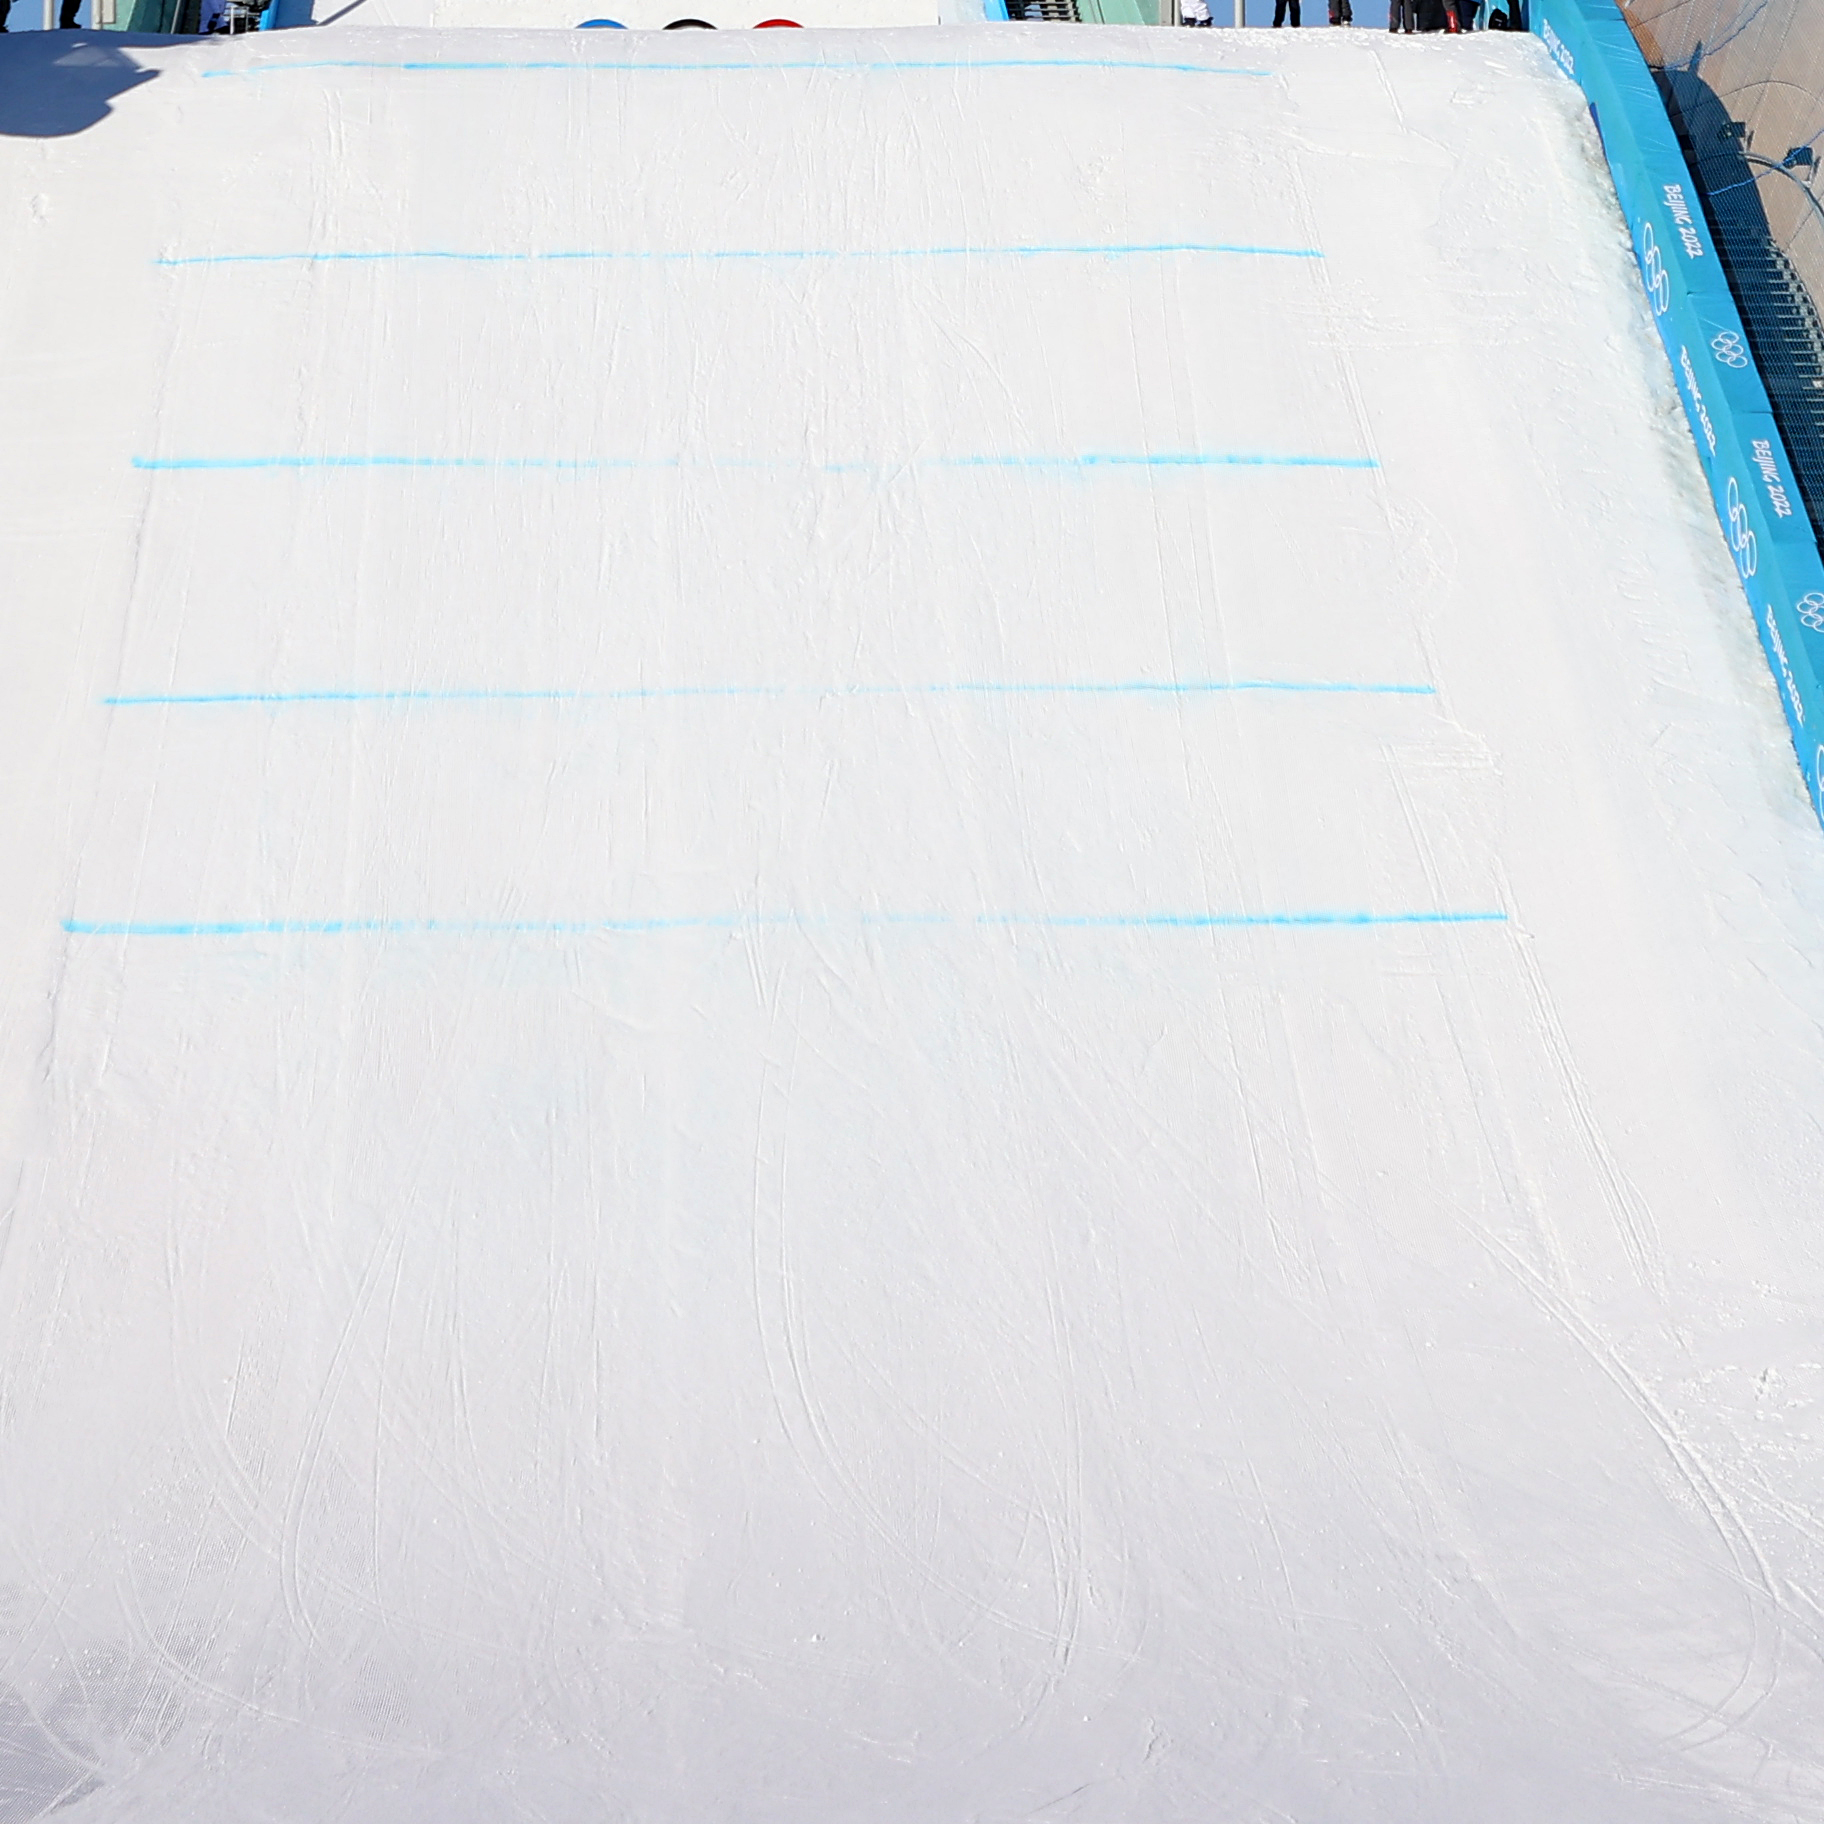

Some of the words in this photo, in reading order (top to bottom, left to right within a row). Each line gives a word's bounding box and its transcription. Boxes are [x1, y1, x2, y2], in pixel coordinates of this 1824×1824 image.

[1663, 184, 1693, 225] BEIJING
[1678, 227, 1704, 260] 2022
[1680, 345, 1702, 412] BEIJING
[1700, 404, 1716, 457] 2022
[1752, 439, 1781, 483] BEIJING
[1767, 485, 1793, 519] 2022
[1766, 603, 1788, 678] BEIJING
[1787, 670, 1804, 728] 2022
